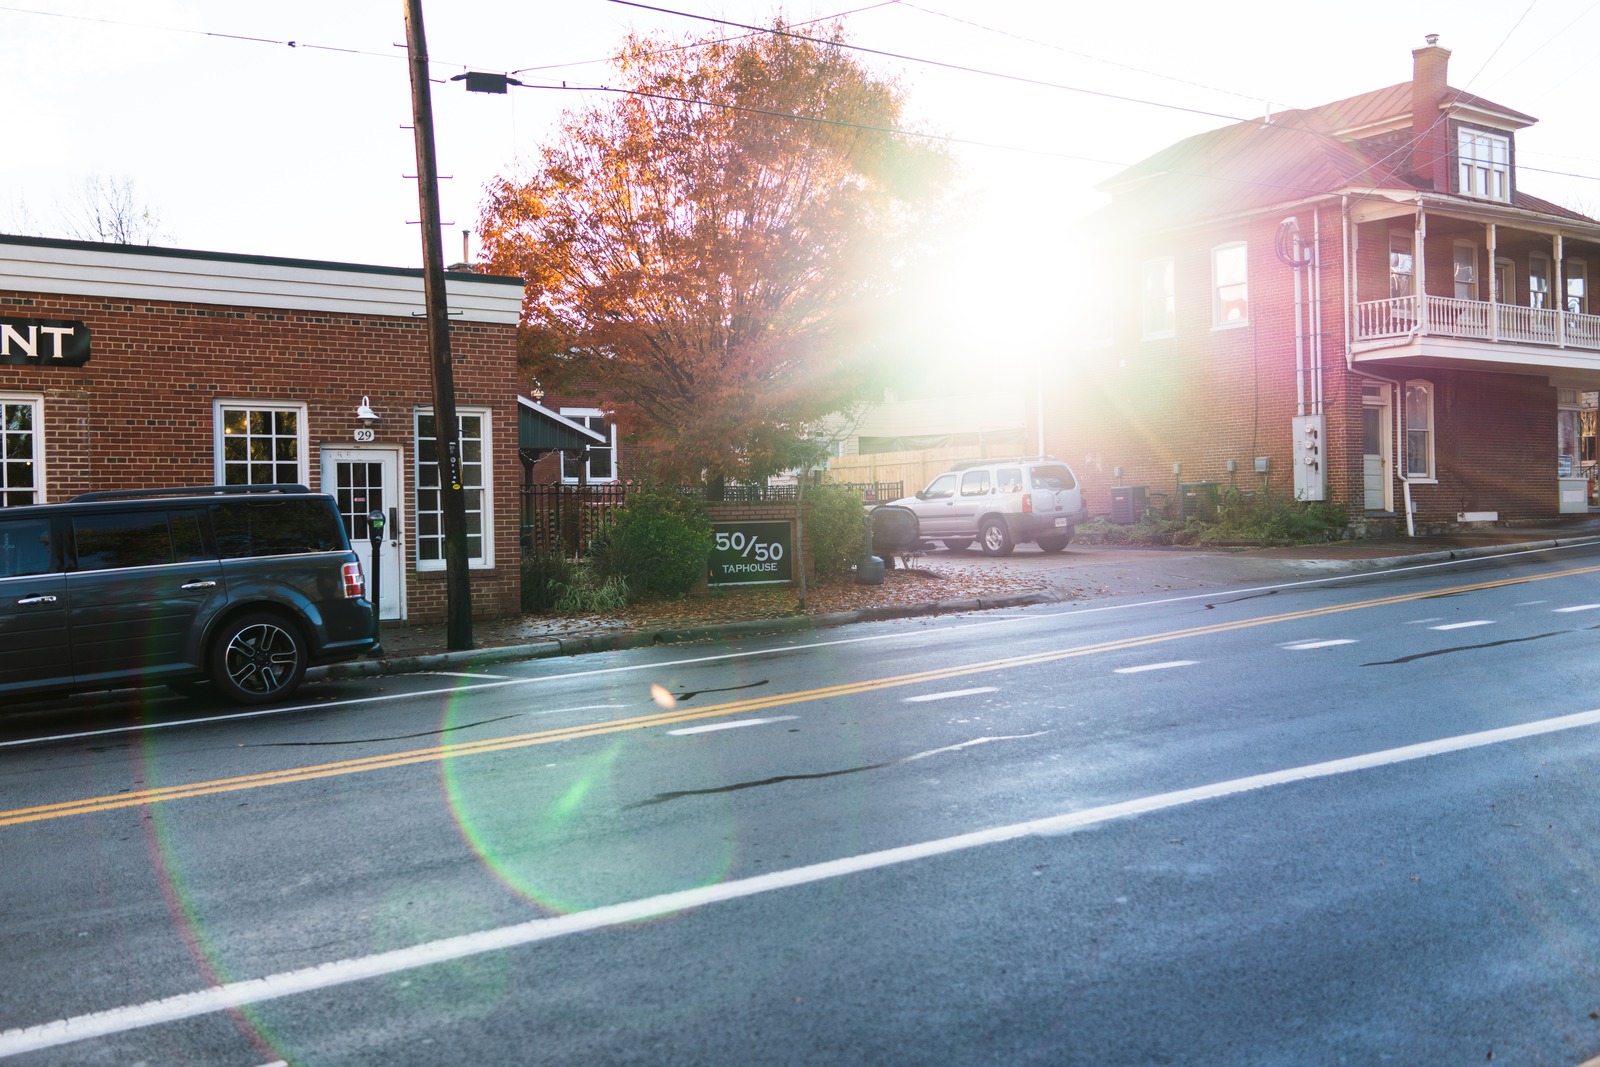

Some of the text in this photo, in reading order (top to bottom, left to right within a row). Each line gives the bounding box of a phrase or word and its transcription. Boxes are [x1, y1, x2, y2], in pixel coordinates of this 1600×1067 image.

[0, 324, 74, 358] NT
[357, 430, 372, 441] 29
[715, 532, 783, 561] 50/50
[722, 562, 777, 573] TAPHOUSE
